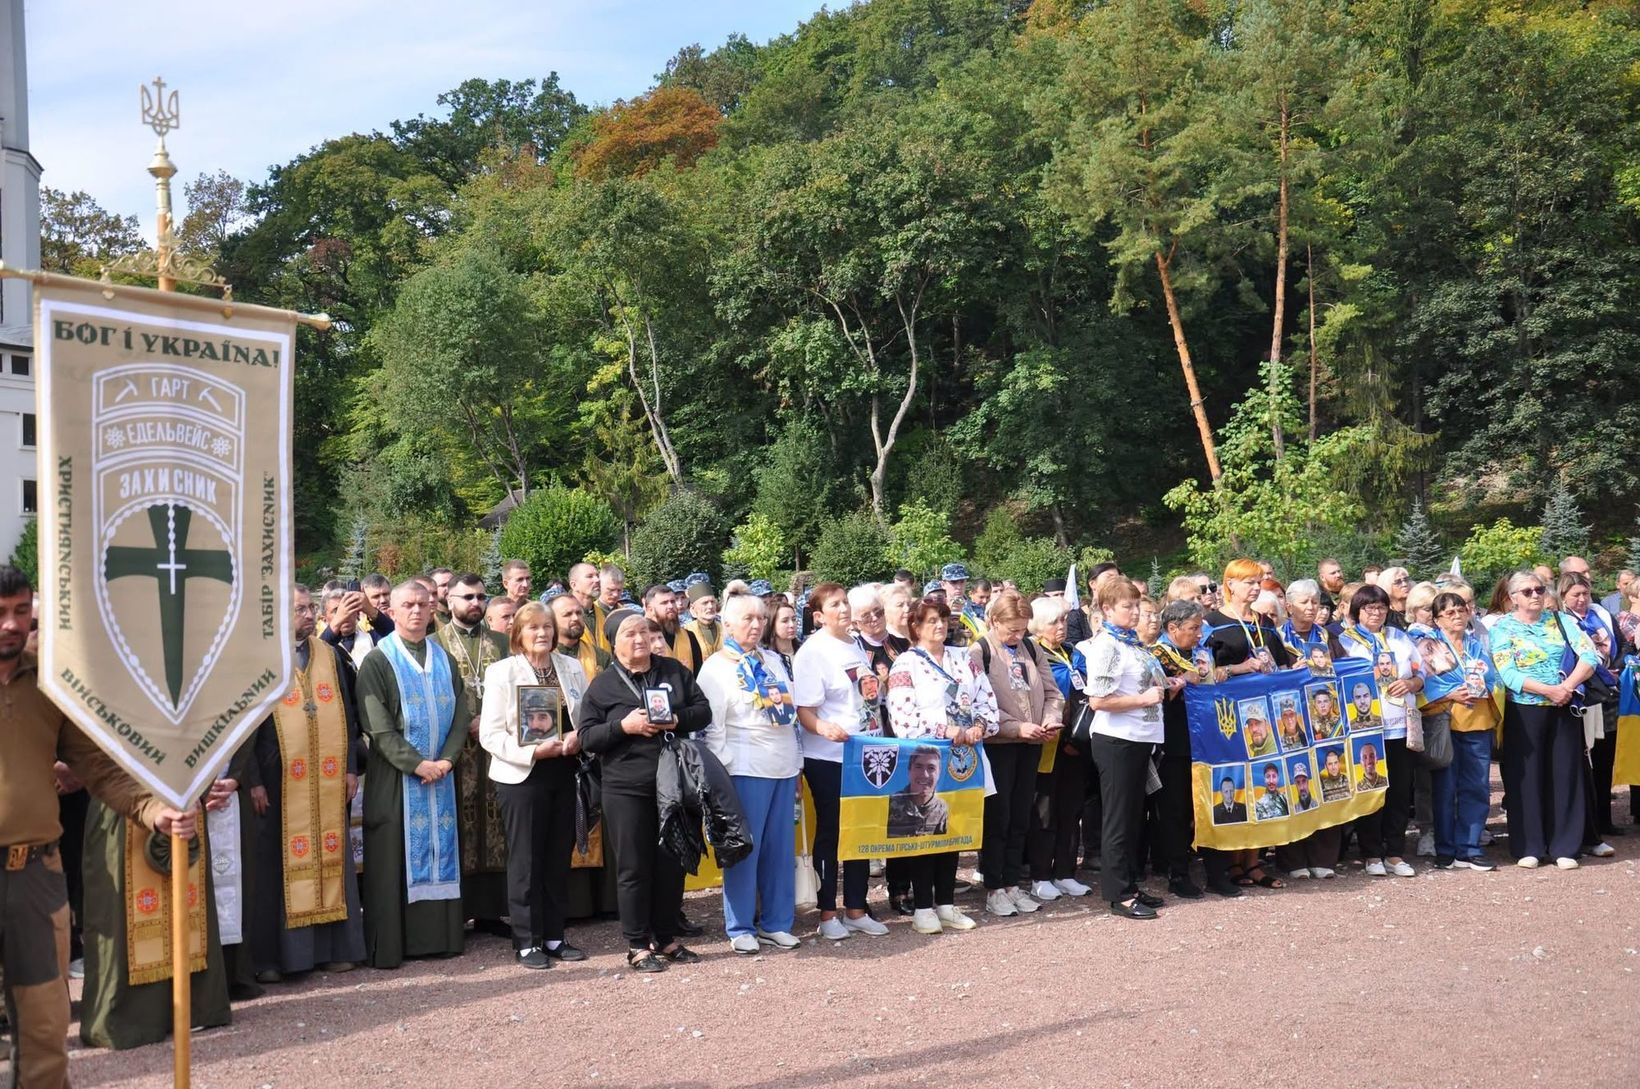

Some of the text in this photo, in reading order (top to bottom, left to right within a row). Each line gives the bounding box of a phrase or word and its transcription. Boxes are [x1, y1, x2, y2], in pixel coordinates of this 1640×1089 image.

[53, 320, 280, 368] БОГ І УКРАЇНА!
[151, 376, 190, 399] ГАРТ
[126, 421, 211, 450] ЕДЕЛЬВЕЙС
[120, 466, 217, 504] ЗАХИСНИК
[263, 584, 275, 640] ТАБІР
[60, 668, 167, 766] ВІЙСЬКОВИЙ
[184, 667, 278, 769] ВИШКІЛЬНИЙ
[858, 844, 869, 854] 128
[870, 842, 895, 853] ОКРЕМА
